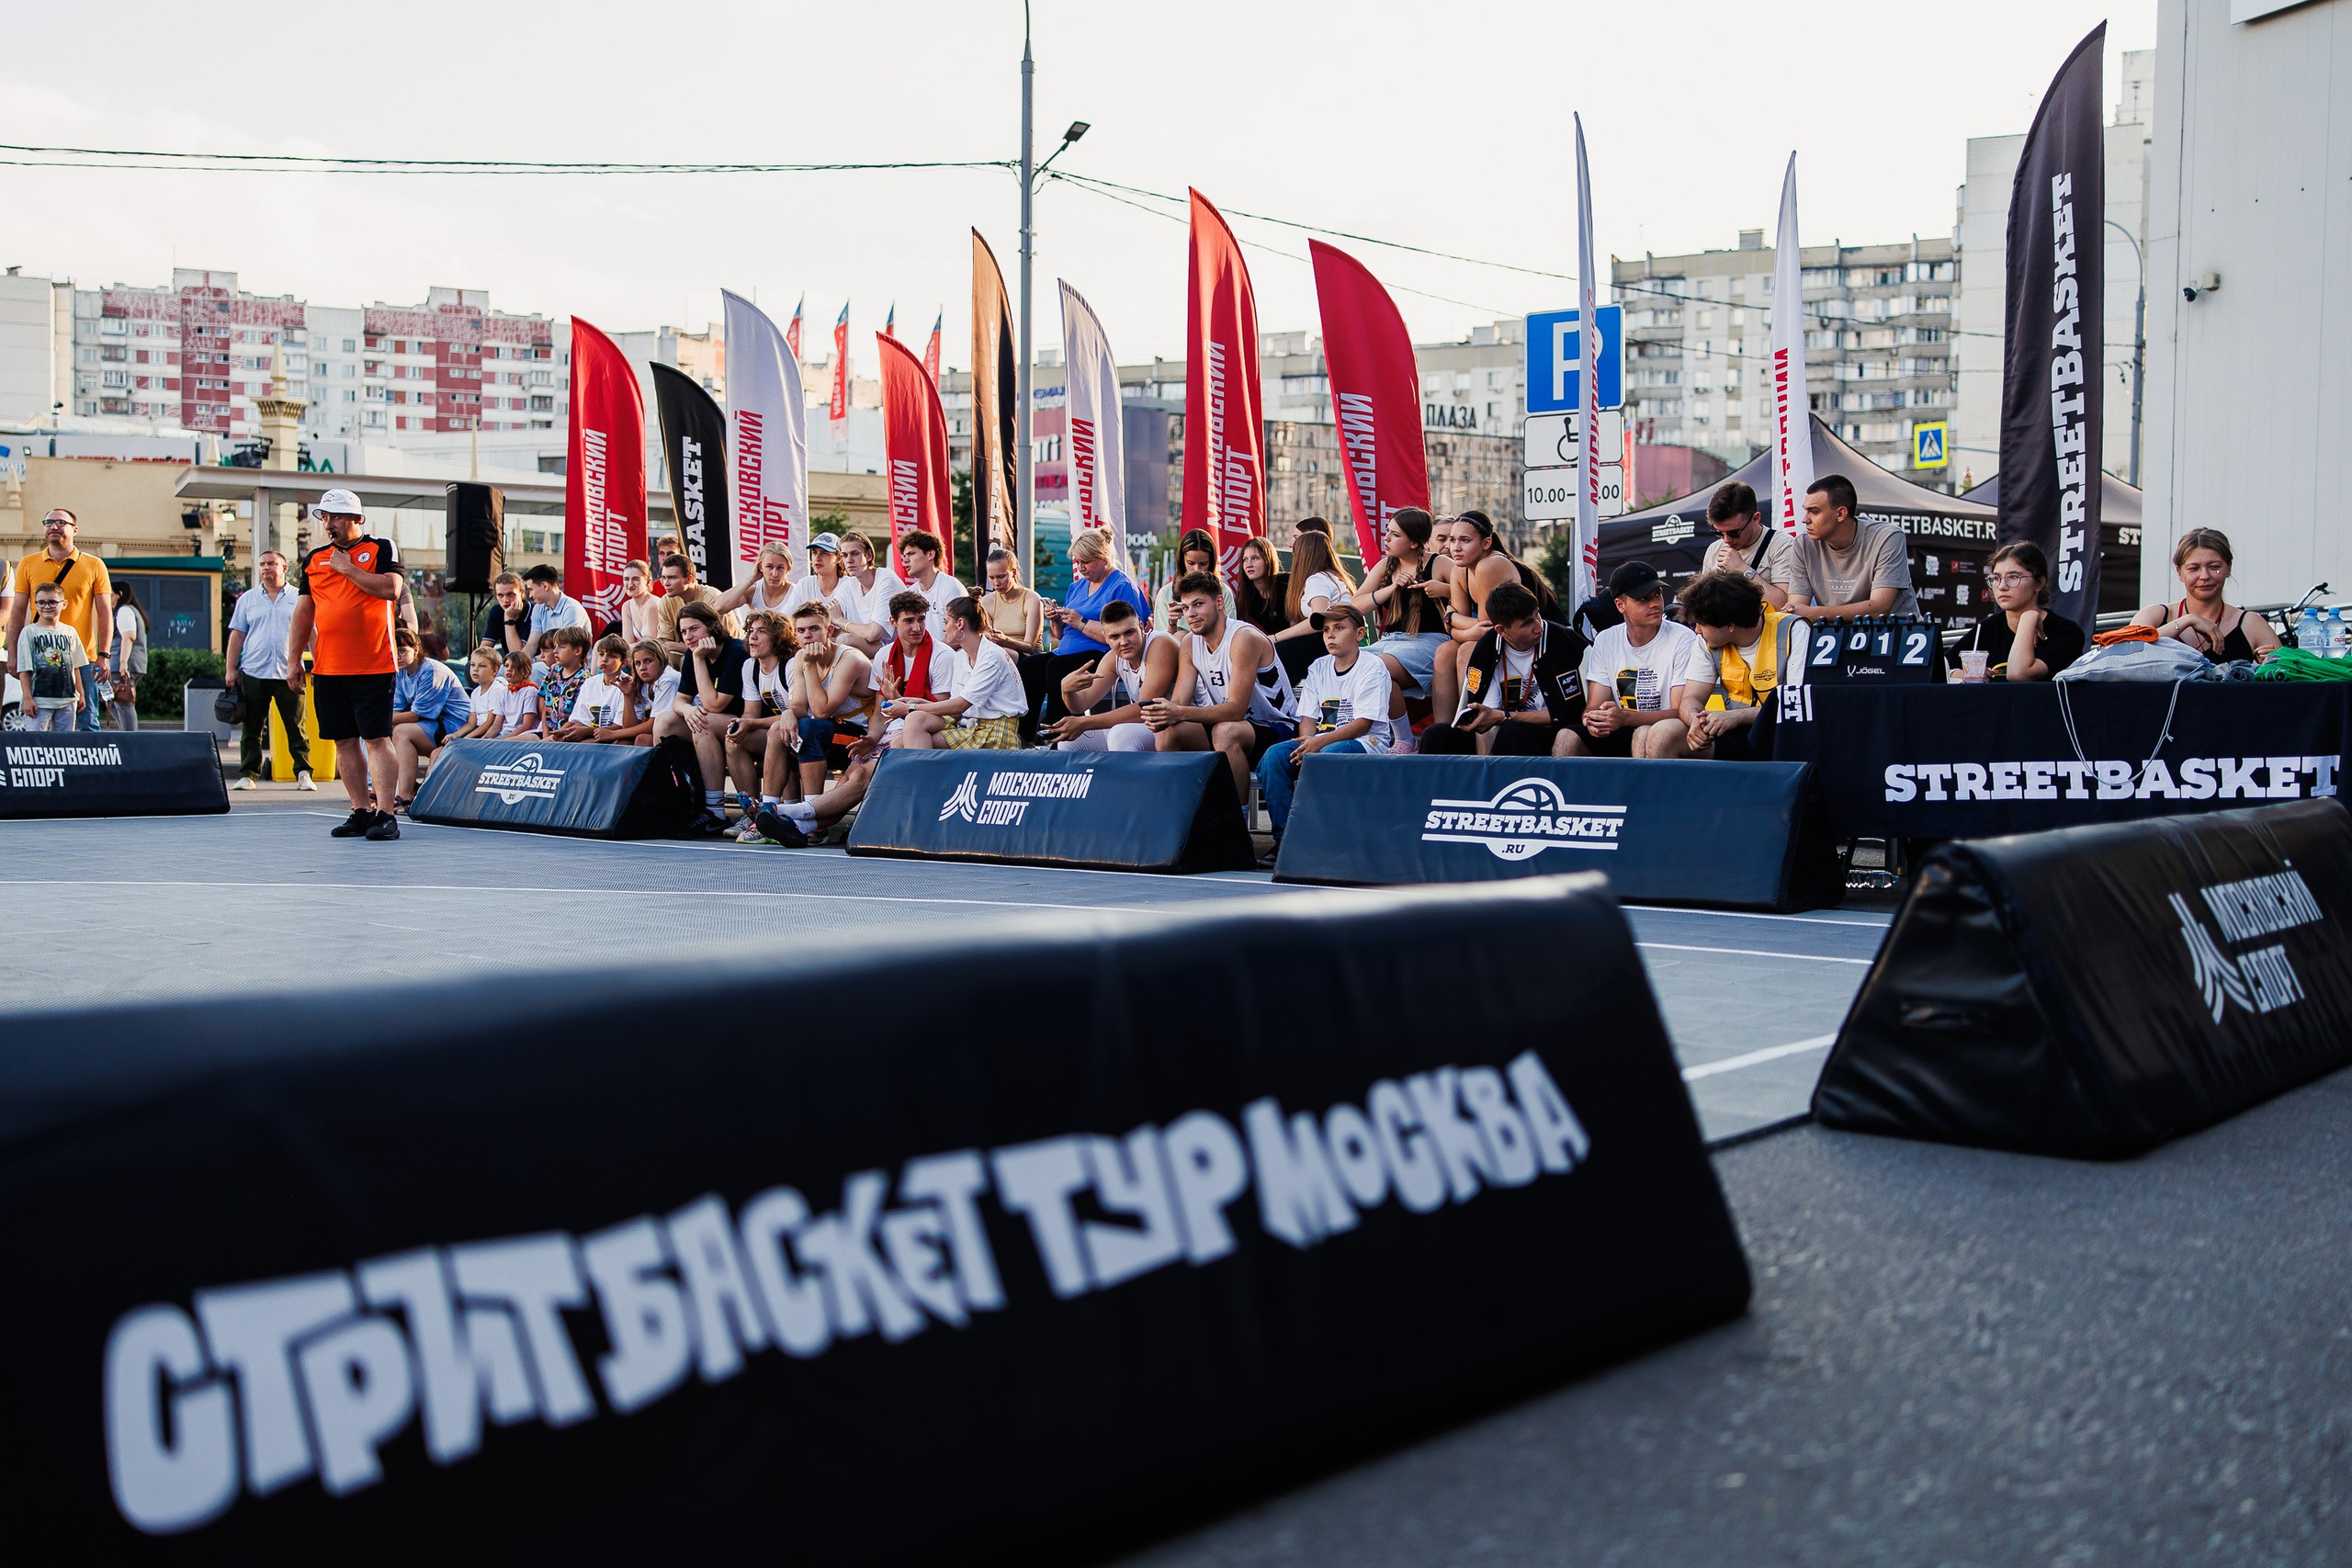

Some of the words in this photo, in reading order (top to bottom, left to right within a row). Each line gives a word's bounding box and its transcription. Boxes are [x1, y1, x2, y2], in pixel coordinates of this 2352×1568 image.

[1553, 320, 1604, 401] P
[2052, 172, 2088, 593] STREETBASKET
[1204, 339, 1226, 530] МОСКОВСКИЙ
[1426, 403, 1476, 429] ПЛАЗА
[582, 427, 607, 572] МОСКОВСКИЙ
[734, 410, 763, 563] МОСКОВСКИЙ
[1224, 445, 1255, 536] СПОРТ
[605, 508, 629, 576] СПОРТ
[1855, 666, 1886, 674] JÖGEL
[6, 743, 122, 766] МОСКОВСКИЙ
[10, 768, 65, 787] СПОРТ
[478, 772, 561, 791] STREETBASKET
[1884, 755, 2341, 803] STREETBASKET
[986, 768, 1094, 800] МОСКОВСКИЙ
[977, 801, 1030, 826] СПОРТ
[1424, 810, 1624, 838] STREETBASKET
[1501, 843, 1526, 854] .RU
[2199, 858, 2324, 944] МОСКОВСКИЙ
[2235, 942, 2306, 1015] СПОРТ
[991, 1110, 1247, 1298] ТУР
[1243, 1051, 1589, 1247] МОСКВА
